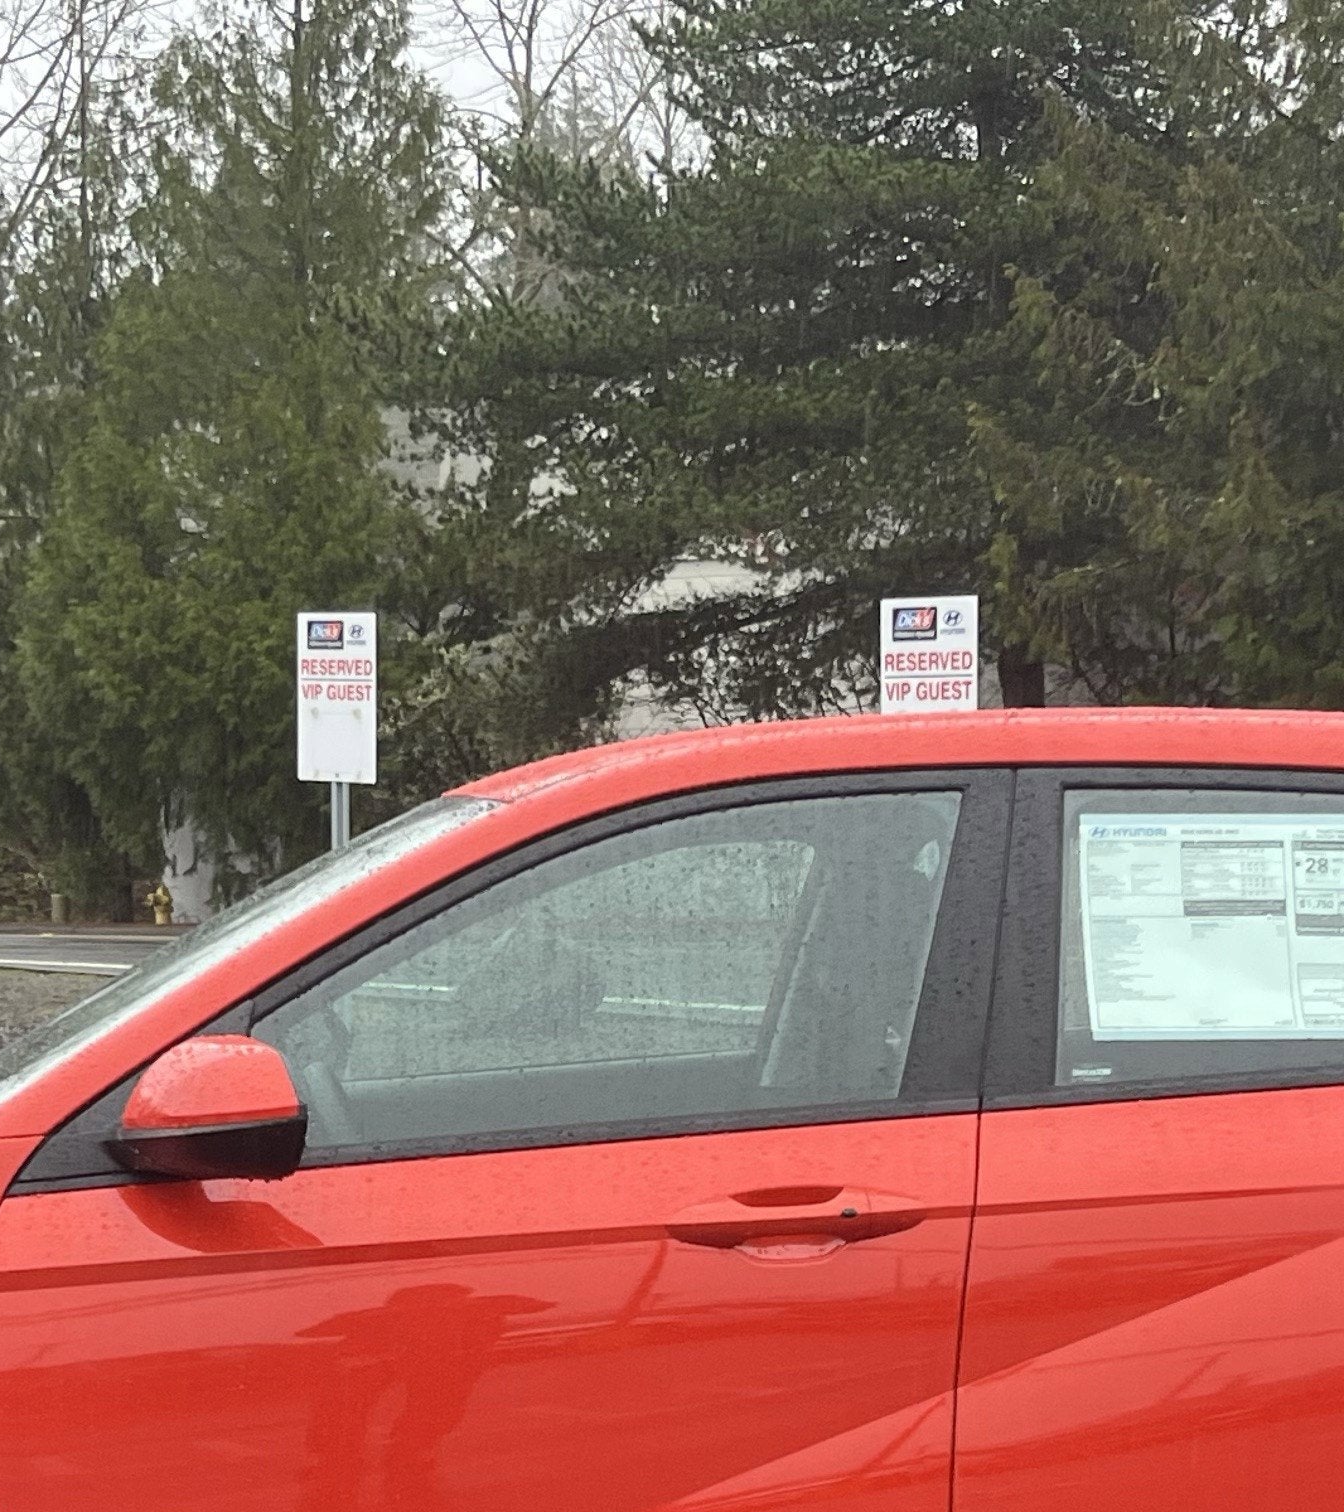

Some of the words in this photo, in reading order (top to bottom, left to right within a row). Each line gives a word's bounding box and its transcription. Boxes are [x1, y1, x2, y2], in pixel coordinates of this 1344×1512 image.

[301, 659, 373, 676] RESERVED
[884, 651, 973, 672] RESERVED
[302, 684, 323, 700] VIP
[327, 684, 372, 701] GUEST
[885, 682, 910, 701] VIP
[916, 681, 972, 701] GUEST
[1113, 828, 1167, 837] HYUNDAI
[1305, 857, 1329, 874] 28
